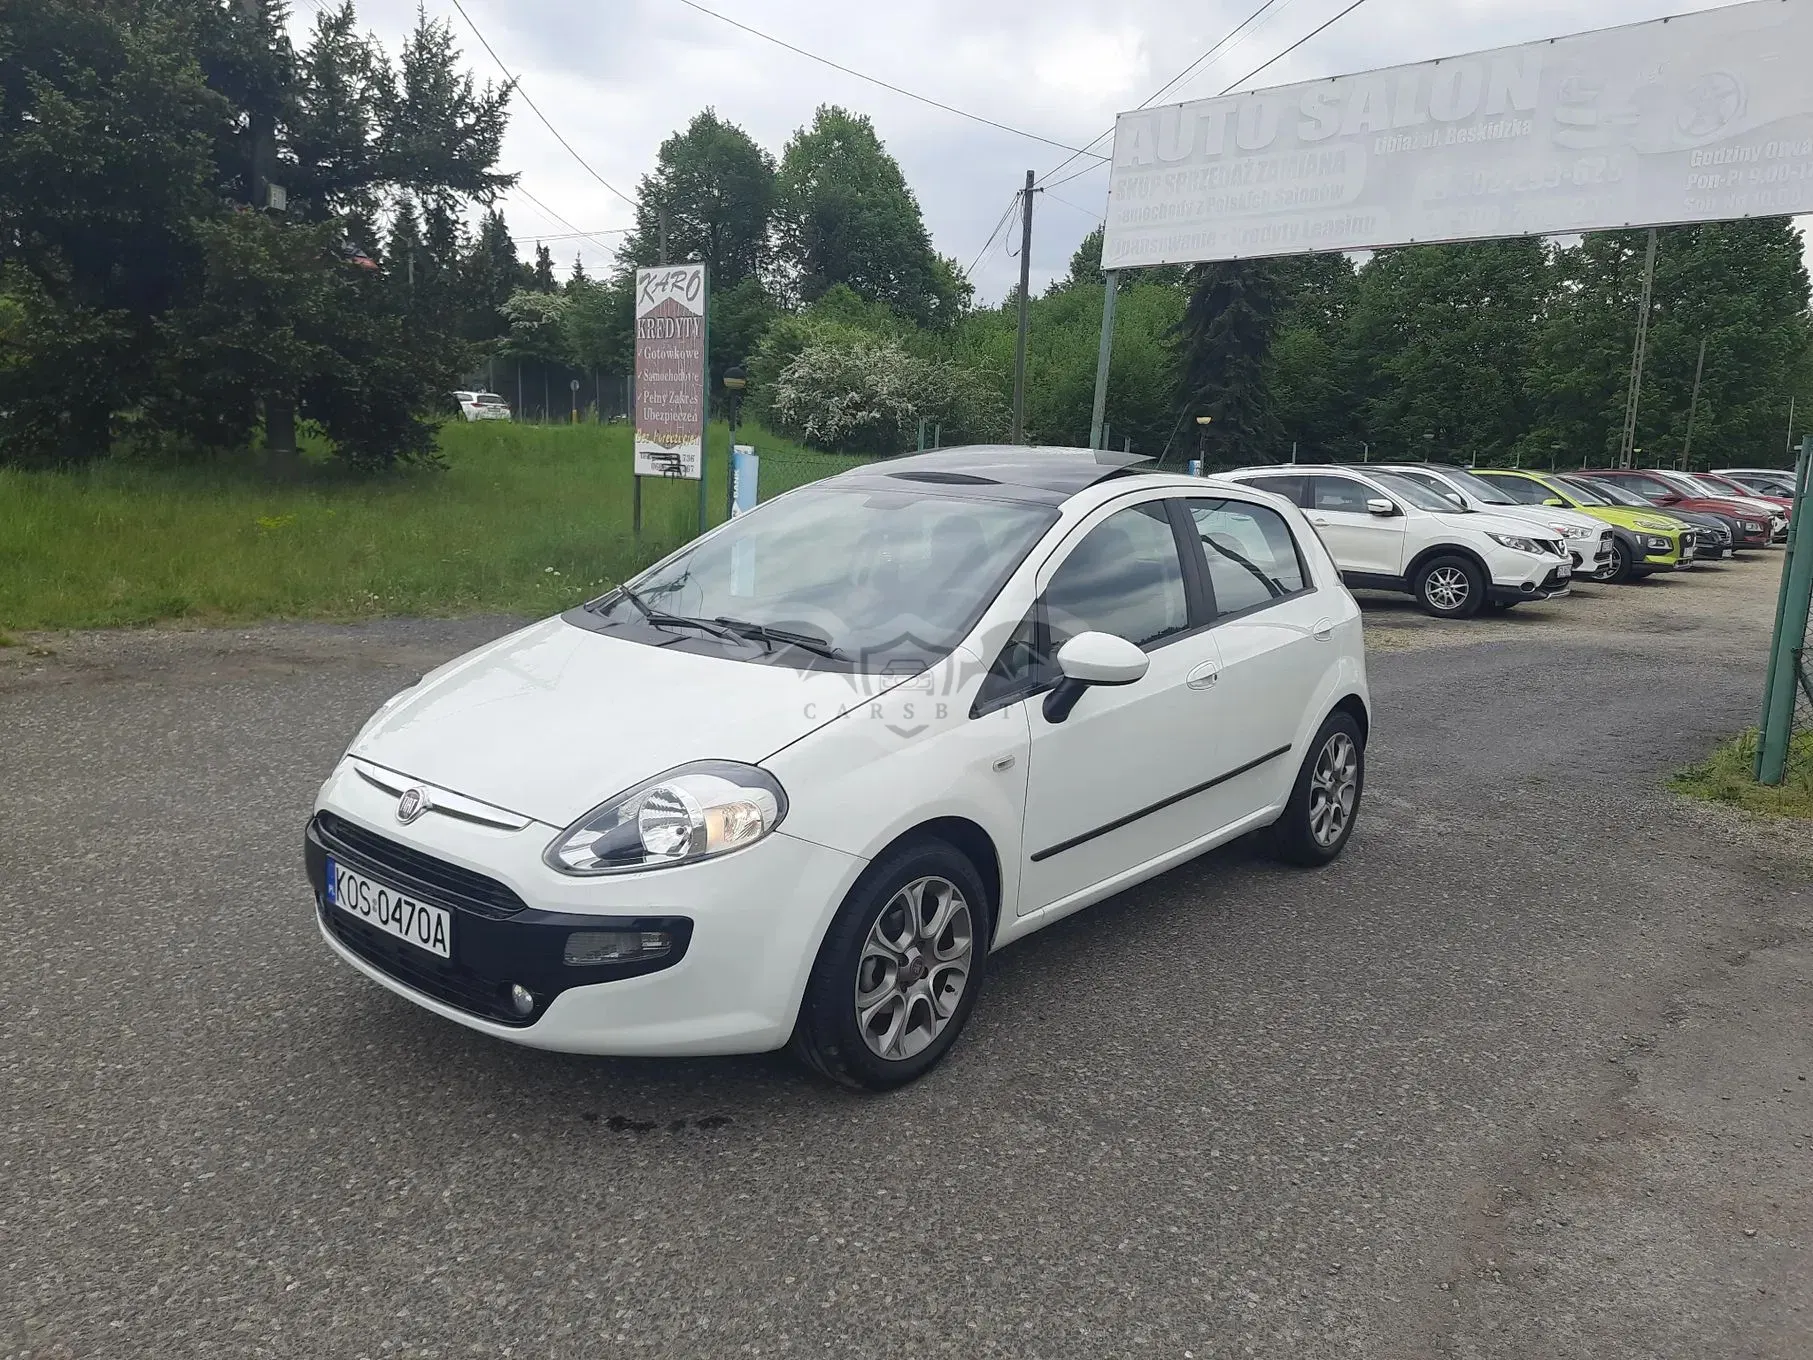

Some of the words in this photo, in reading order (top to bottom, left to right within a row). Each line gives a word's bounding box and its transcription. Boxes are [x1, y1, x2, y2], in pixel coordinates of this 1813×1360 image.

[1117, 97, 1281, 169] AUTO
[1297, 51, 1543, 143] SALON
[1446, 119, 1531, 145] Beskidzka
[1690, 145, 1761, 168] Godziny
[638, 270, 701, 307] KARO
[637, 317, 701, 339] KREDYTY
[336, 866, 371, 916] KOS
[378, 889, 447, 953] 0470A
